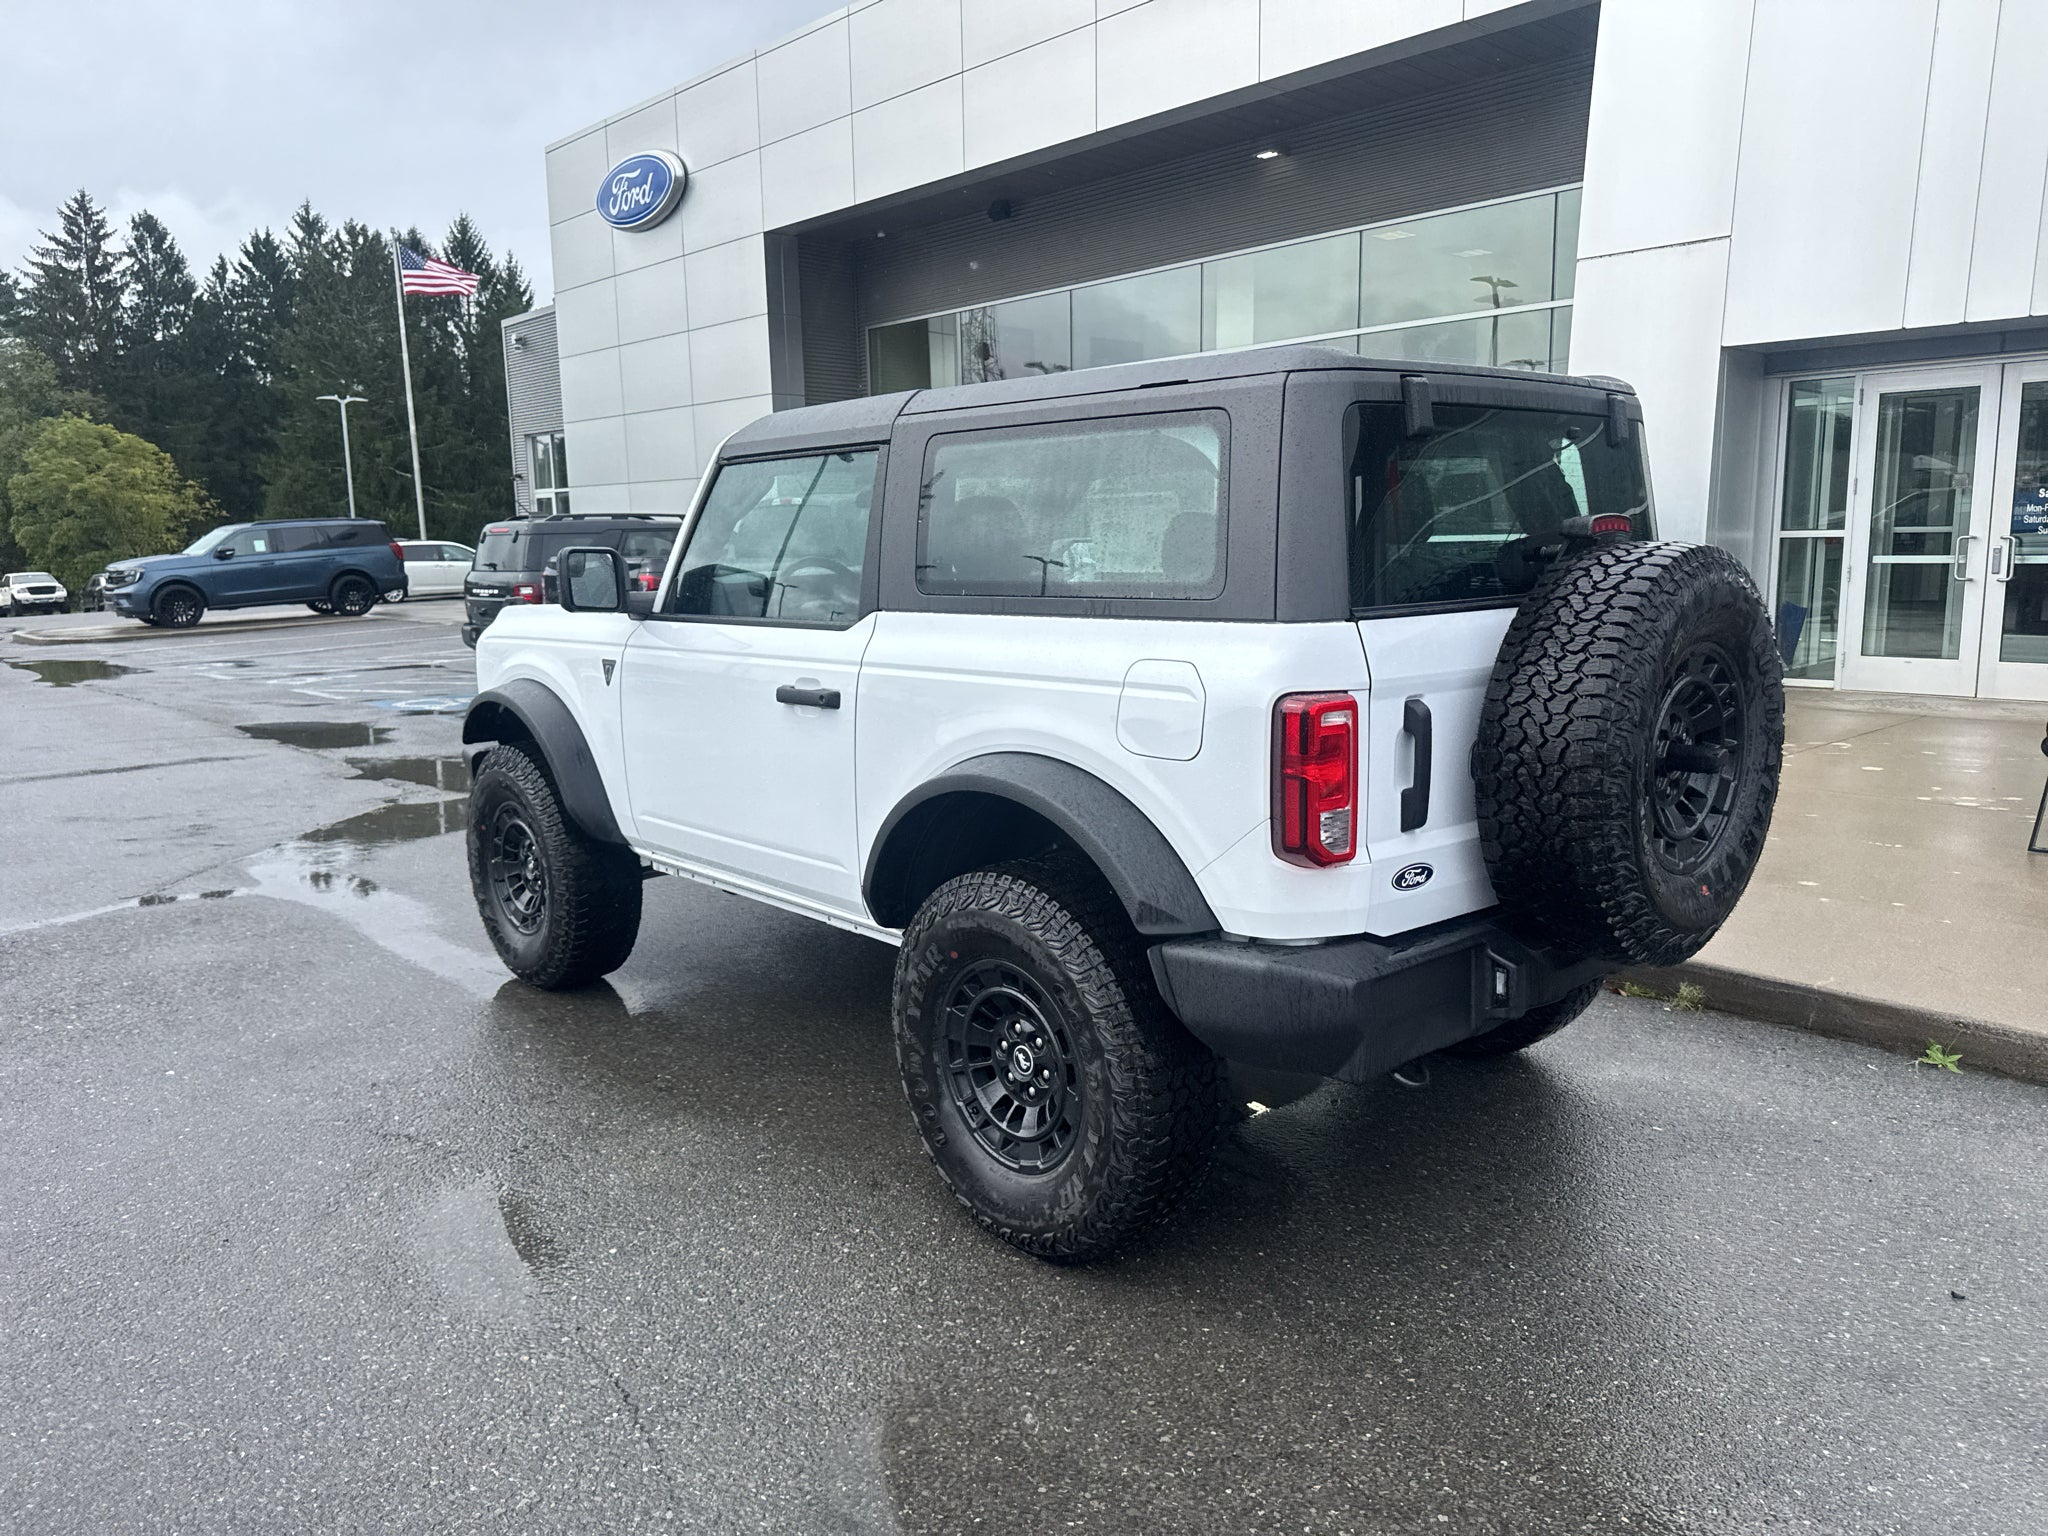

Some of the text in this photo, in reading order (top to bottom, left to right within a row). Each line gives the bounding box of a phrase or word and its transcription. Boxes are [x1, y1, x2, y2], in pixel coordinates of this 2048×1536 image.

[609, 167, 654, 216] Ford
[2023, 514, 2048, 524] Saturd
[1401, 868, 1428, 887] Ford
